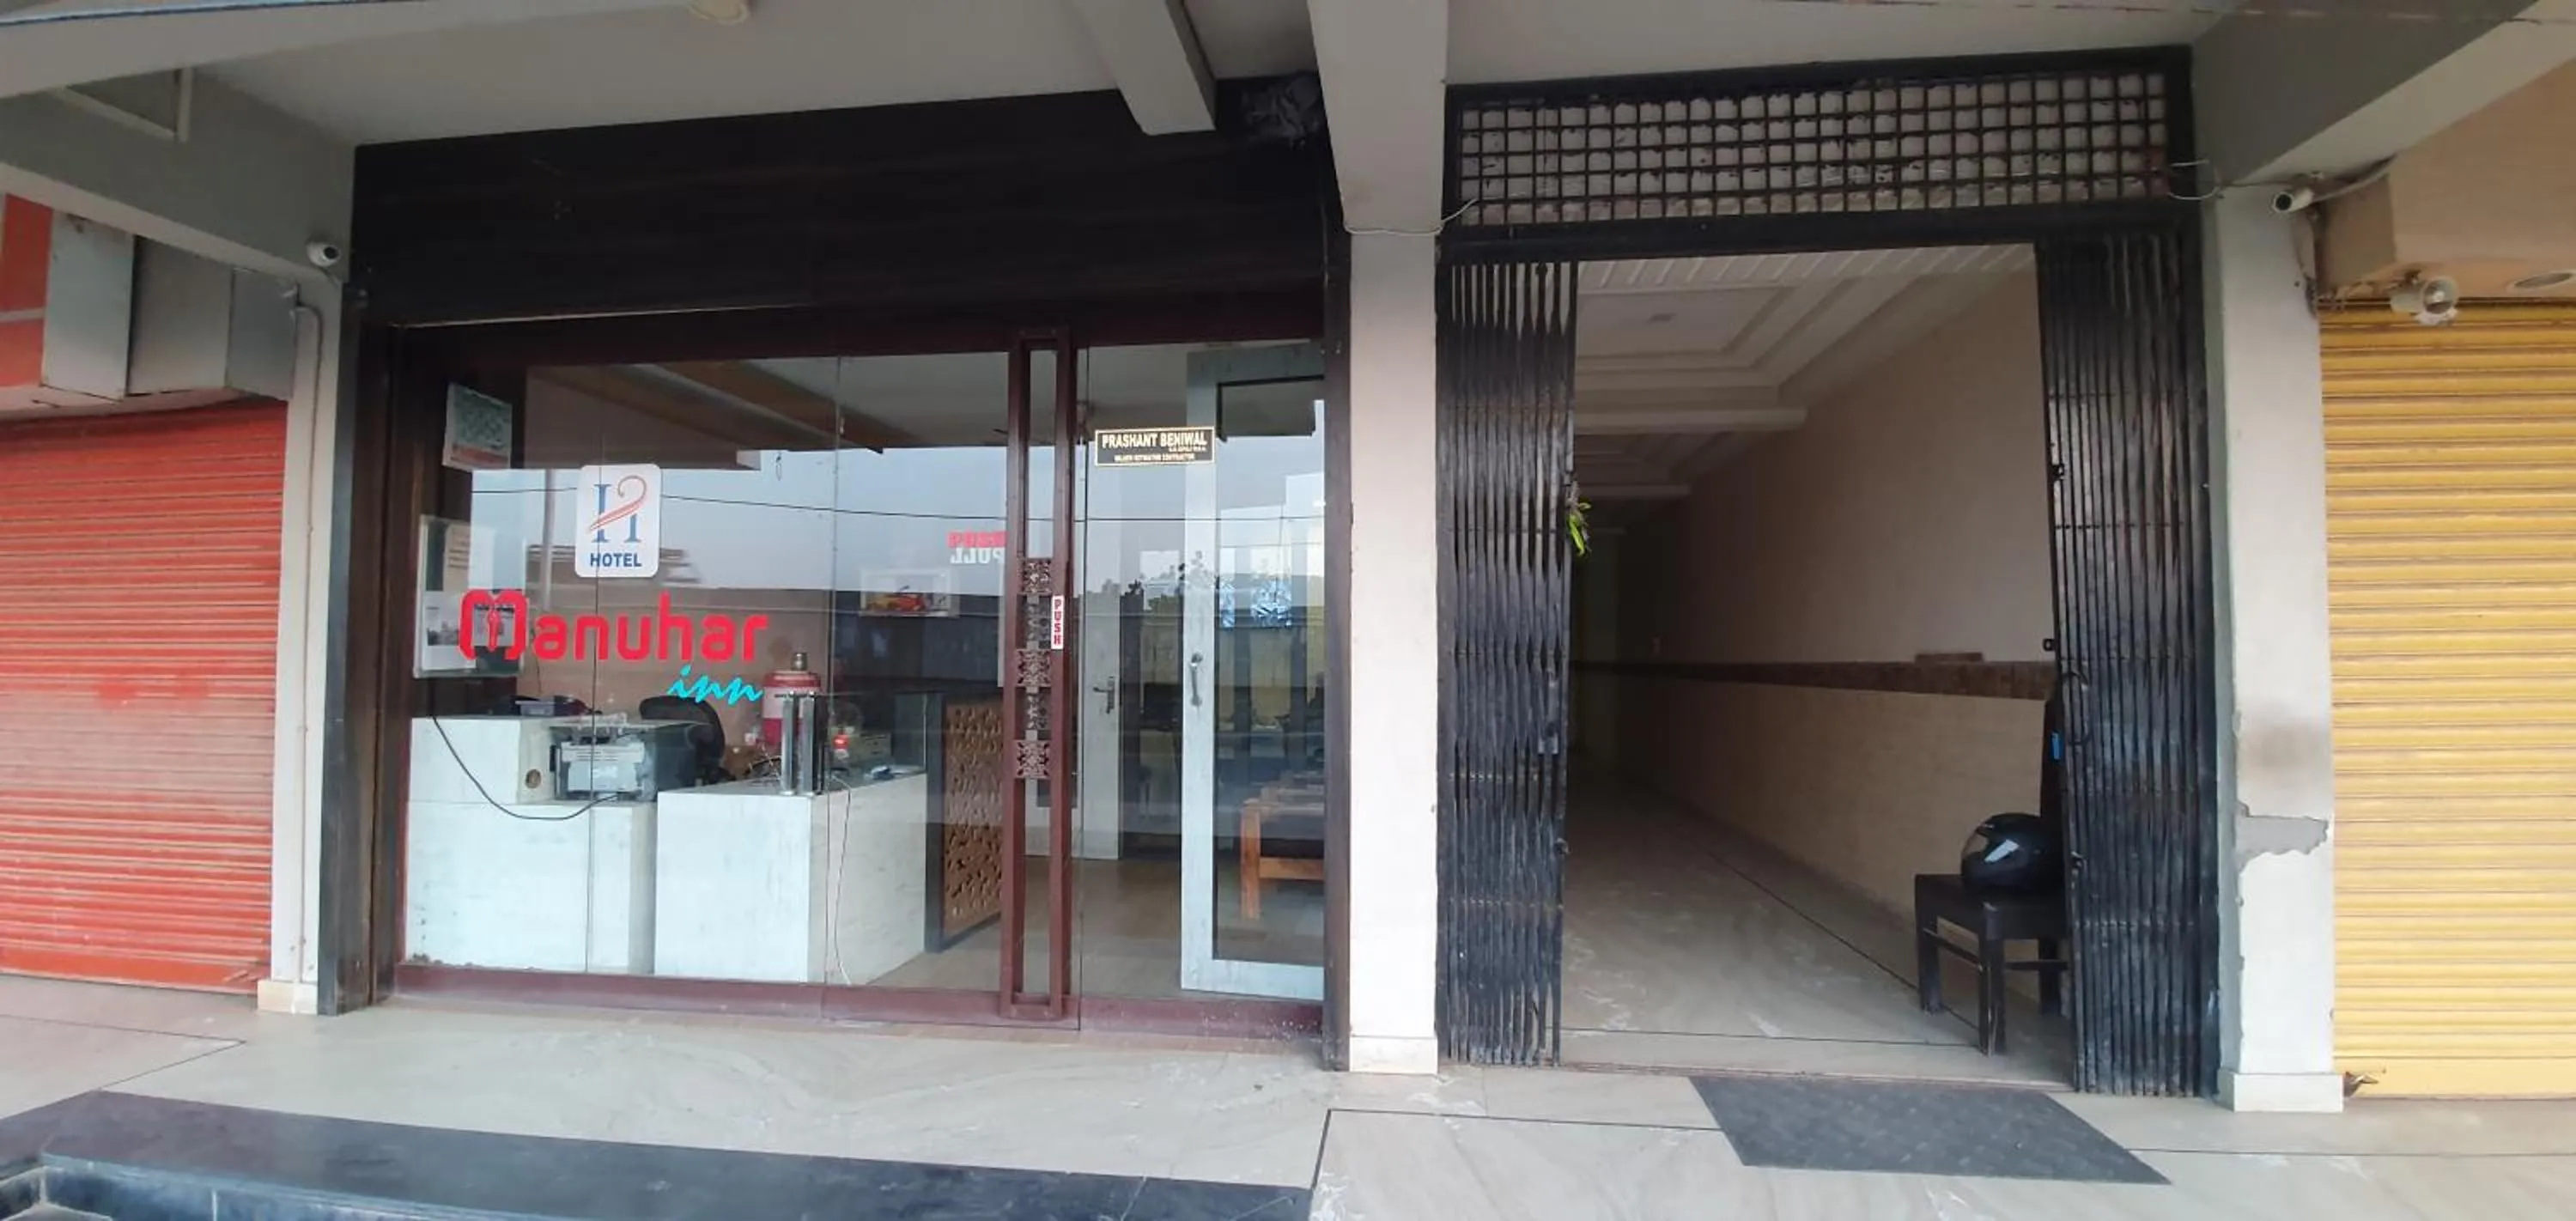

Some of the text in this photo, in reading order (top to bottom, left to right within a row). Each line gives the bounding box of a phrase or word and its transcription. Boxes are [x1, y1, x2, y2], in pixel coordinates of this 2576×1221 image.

[1102, 431, 1207, 448] PRASHANT BENIWAL
[590, 552, 642, 568] HOTEL
[459, 589, 769, 661] Manuhar
[1054, 598, 1062, 646] PUSH
[666, 665, 763, 705] inn
